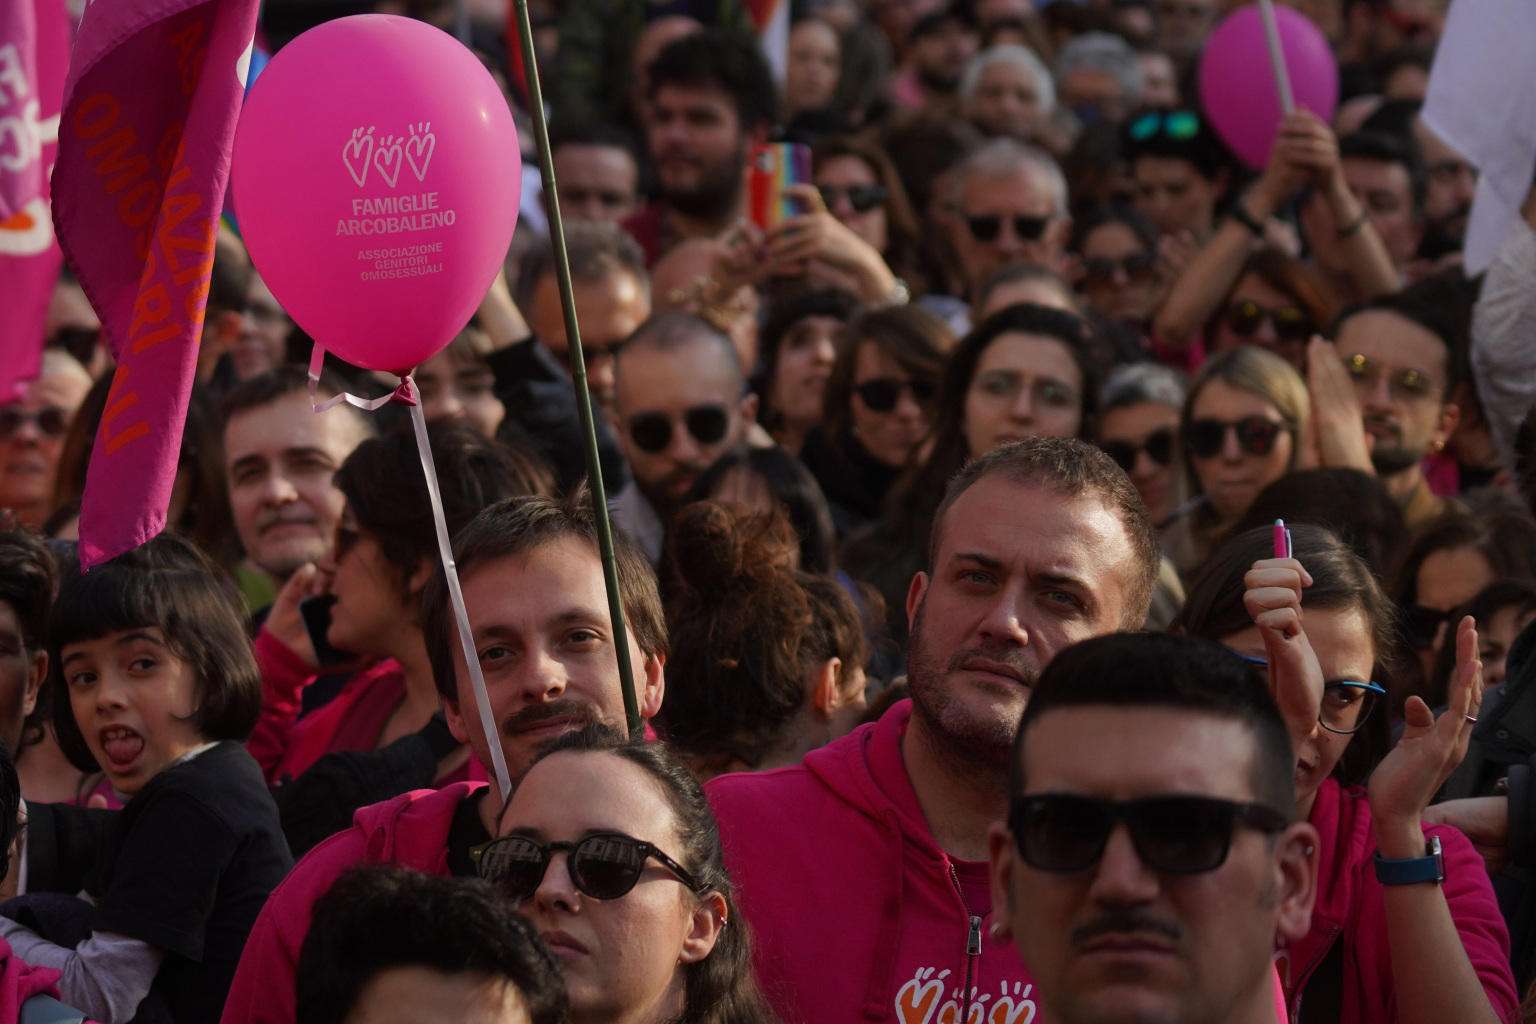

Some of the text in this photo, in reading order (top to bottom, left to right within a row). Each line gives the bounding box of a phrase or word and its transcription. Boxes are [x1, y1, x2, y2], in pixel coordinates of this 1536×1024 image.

[352, 192, 438, 216] FAMIGLIE
[336, 210, 456, 235] ARCOBALENO
[358, 242, 443, 259] ASSOCIAZIONE
[375, 256, 428, 269] GENITORI
[361, 263, 442, 280] OMOSESSUALI
